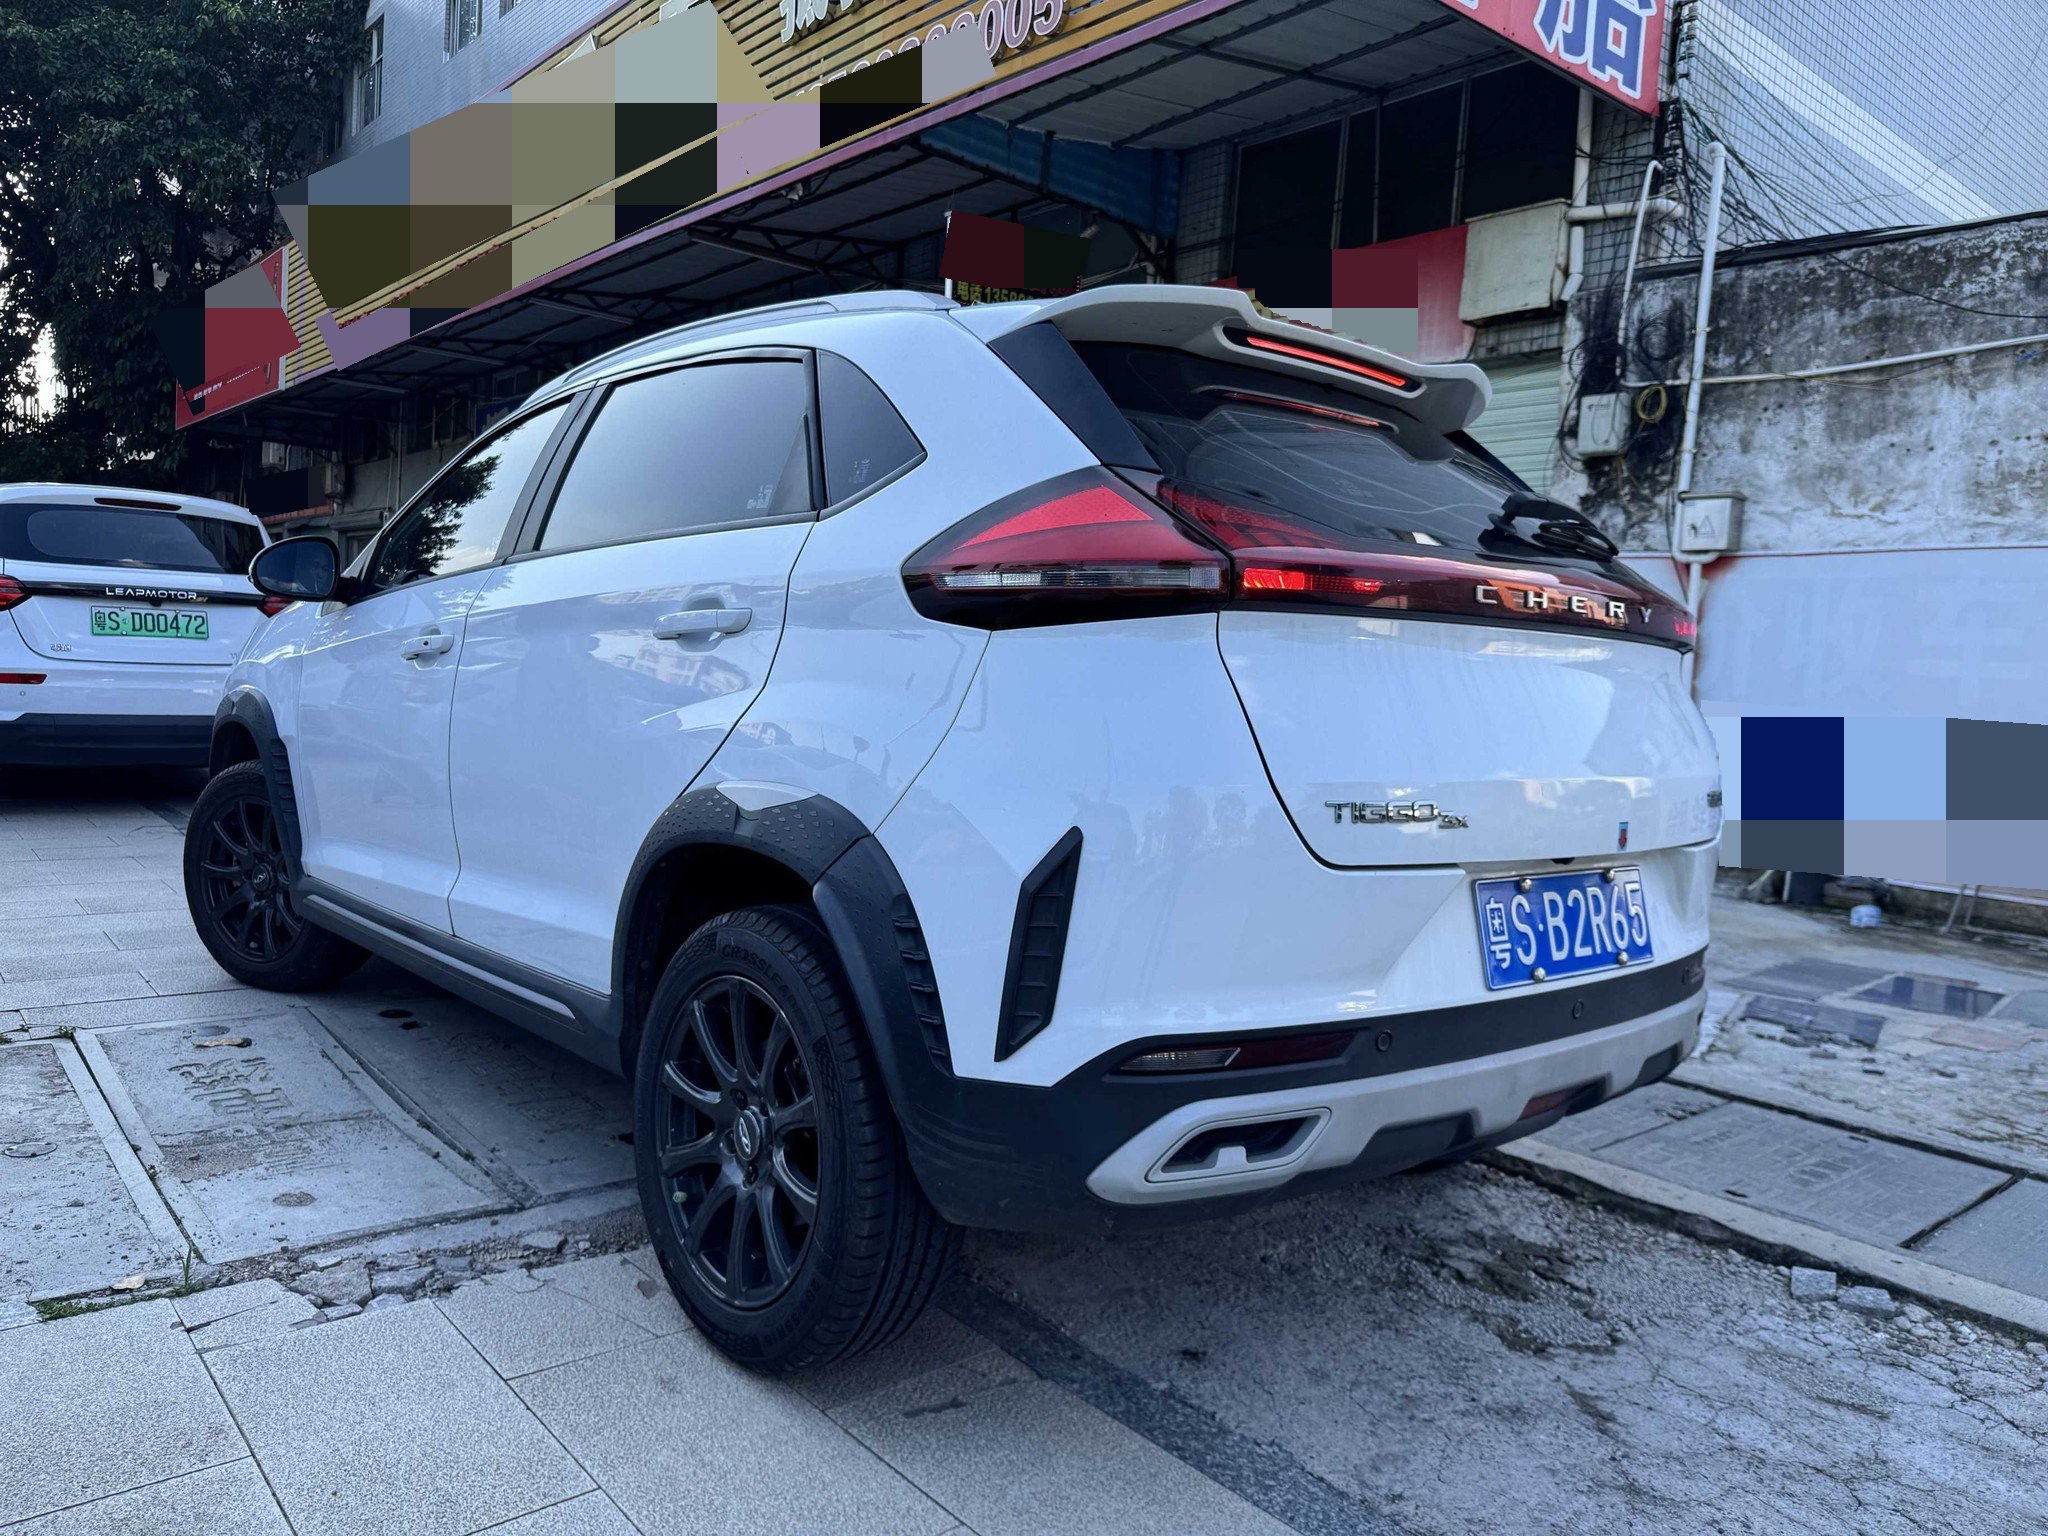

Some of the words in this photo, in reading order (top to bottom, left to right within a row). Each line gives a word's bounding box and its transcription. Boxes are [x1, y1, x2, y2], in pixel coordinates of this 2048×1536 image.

[105, 587, 198, 600] LEAPMOTOR
[1475, 585, 1652, 623] CHERY
[1325, 800, 1438, 824] TIGGO
